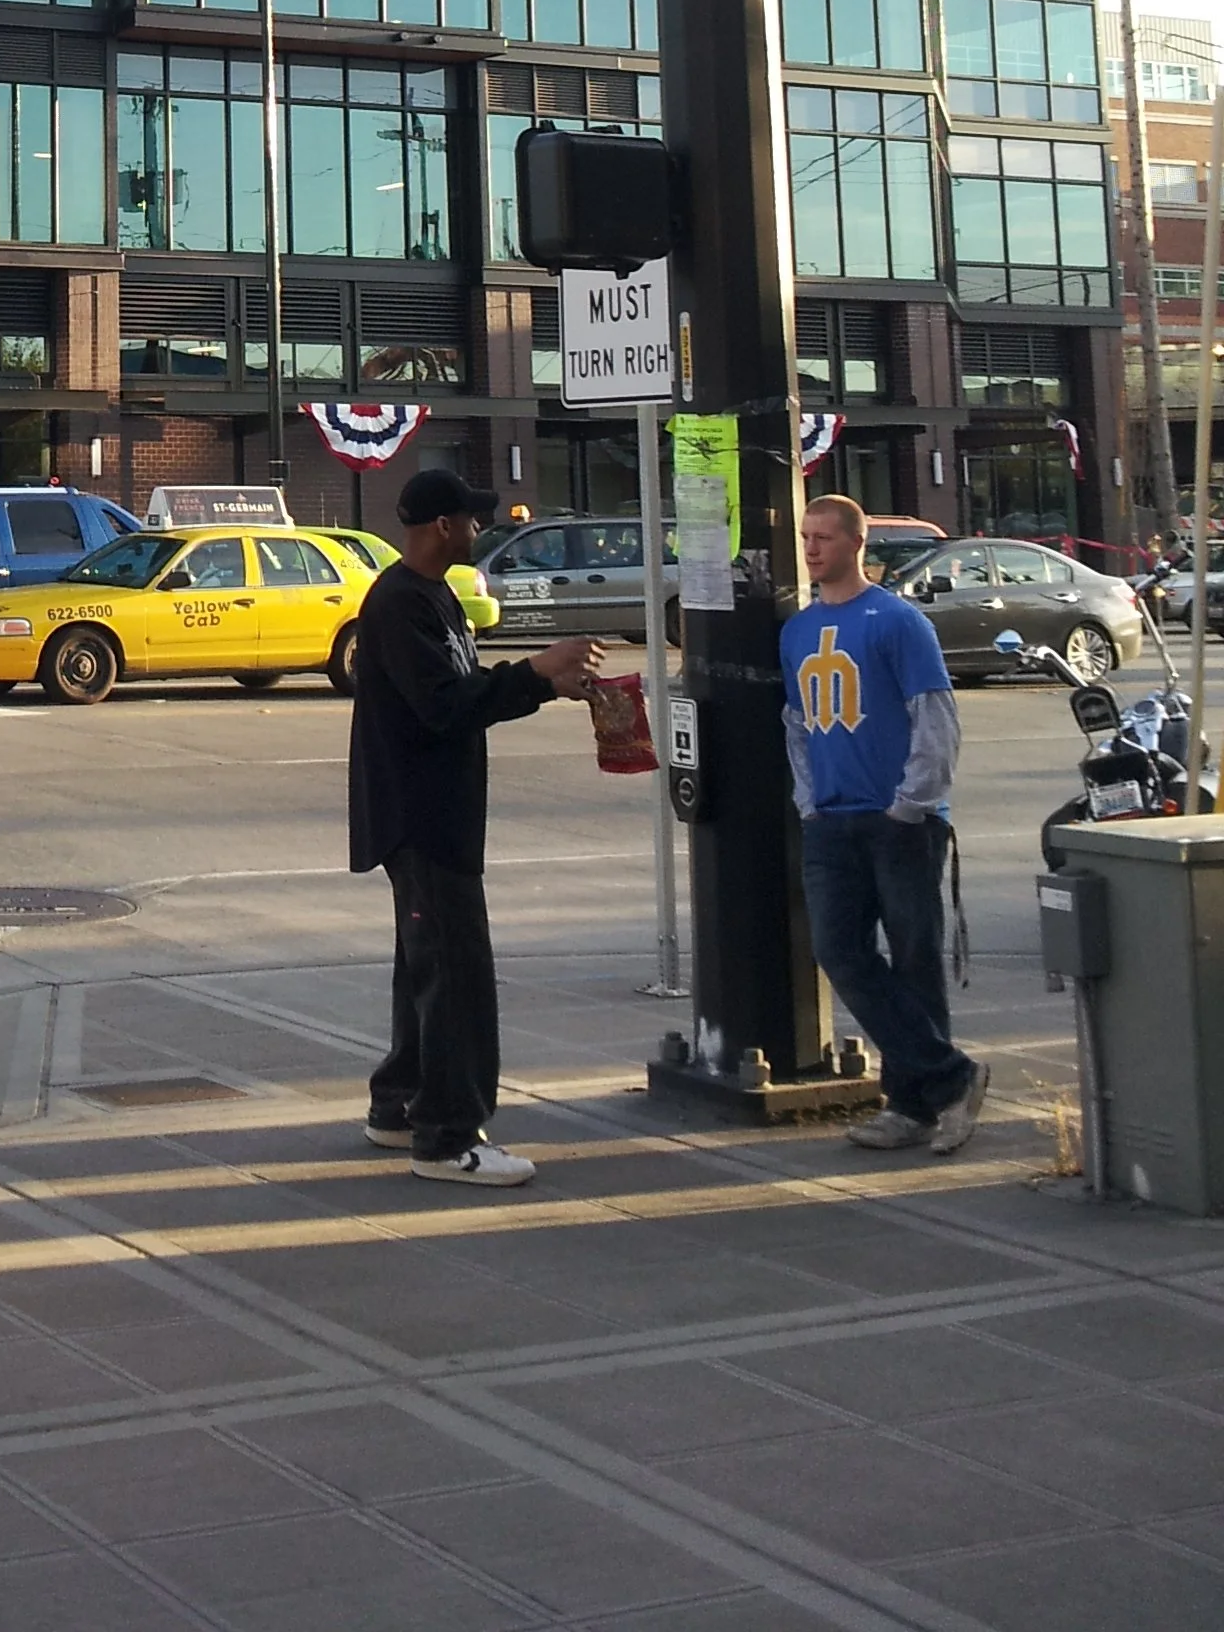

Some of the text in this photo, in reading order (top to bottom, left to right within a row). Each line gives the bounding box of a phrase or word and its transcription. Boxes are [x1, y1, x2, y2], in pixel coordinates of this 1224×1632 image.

[589, 283, 652, 324] MUST
[568, 348, 615, 379] TURN
[624, 343, 669, 375] RIGH
[212, 502, 275, 513] ST-GERMAIN
[47, 604, 113, 621] 622-6500
[173, 600, 231, 615] Yellow
[183, 614, 221, 628] Cab
